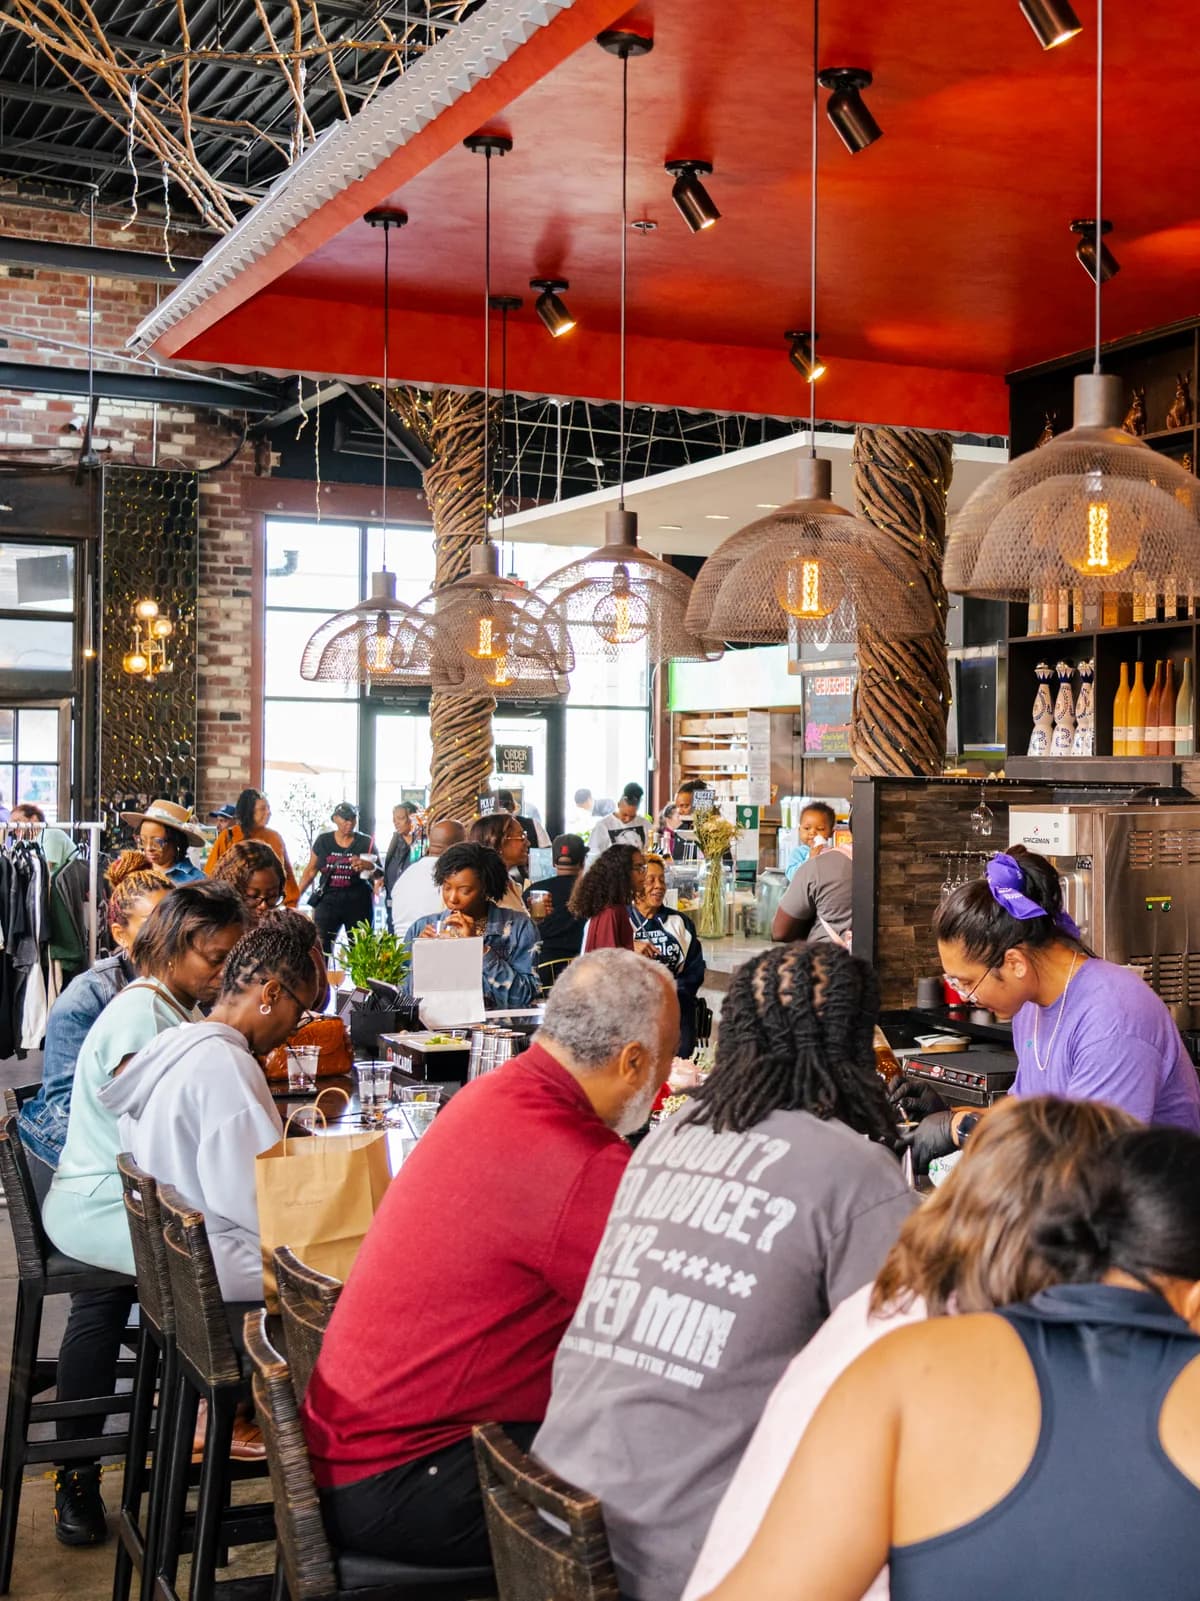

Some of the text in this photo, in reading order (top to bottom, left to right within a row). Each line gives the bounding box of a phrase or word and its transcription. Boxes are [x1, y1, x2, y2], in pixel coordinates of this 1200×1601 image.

[503, 749, 528, 760] ORDER
[502, 760, 525, 773] HERE
[634, 1171, 797, 1253] ADVICE?
